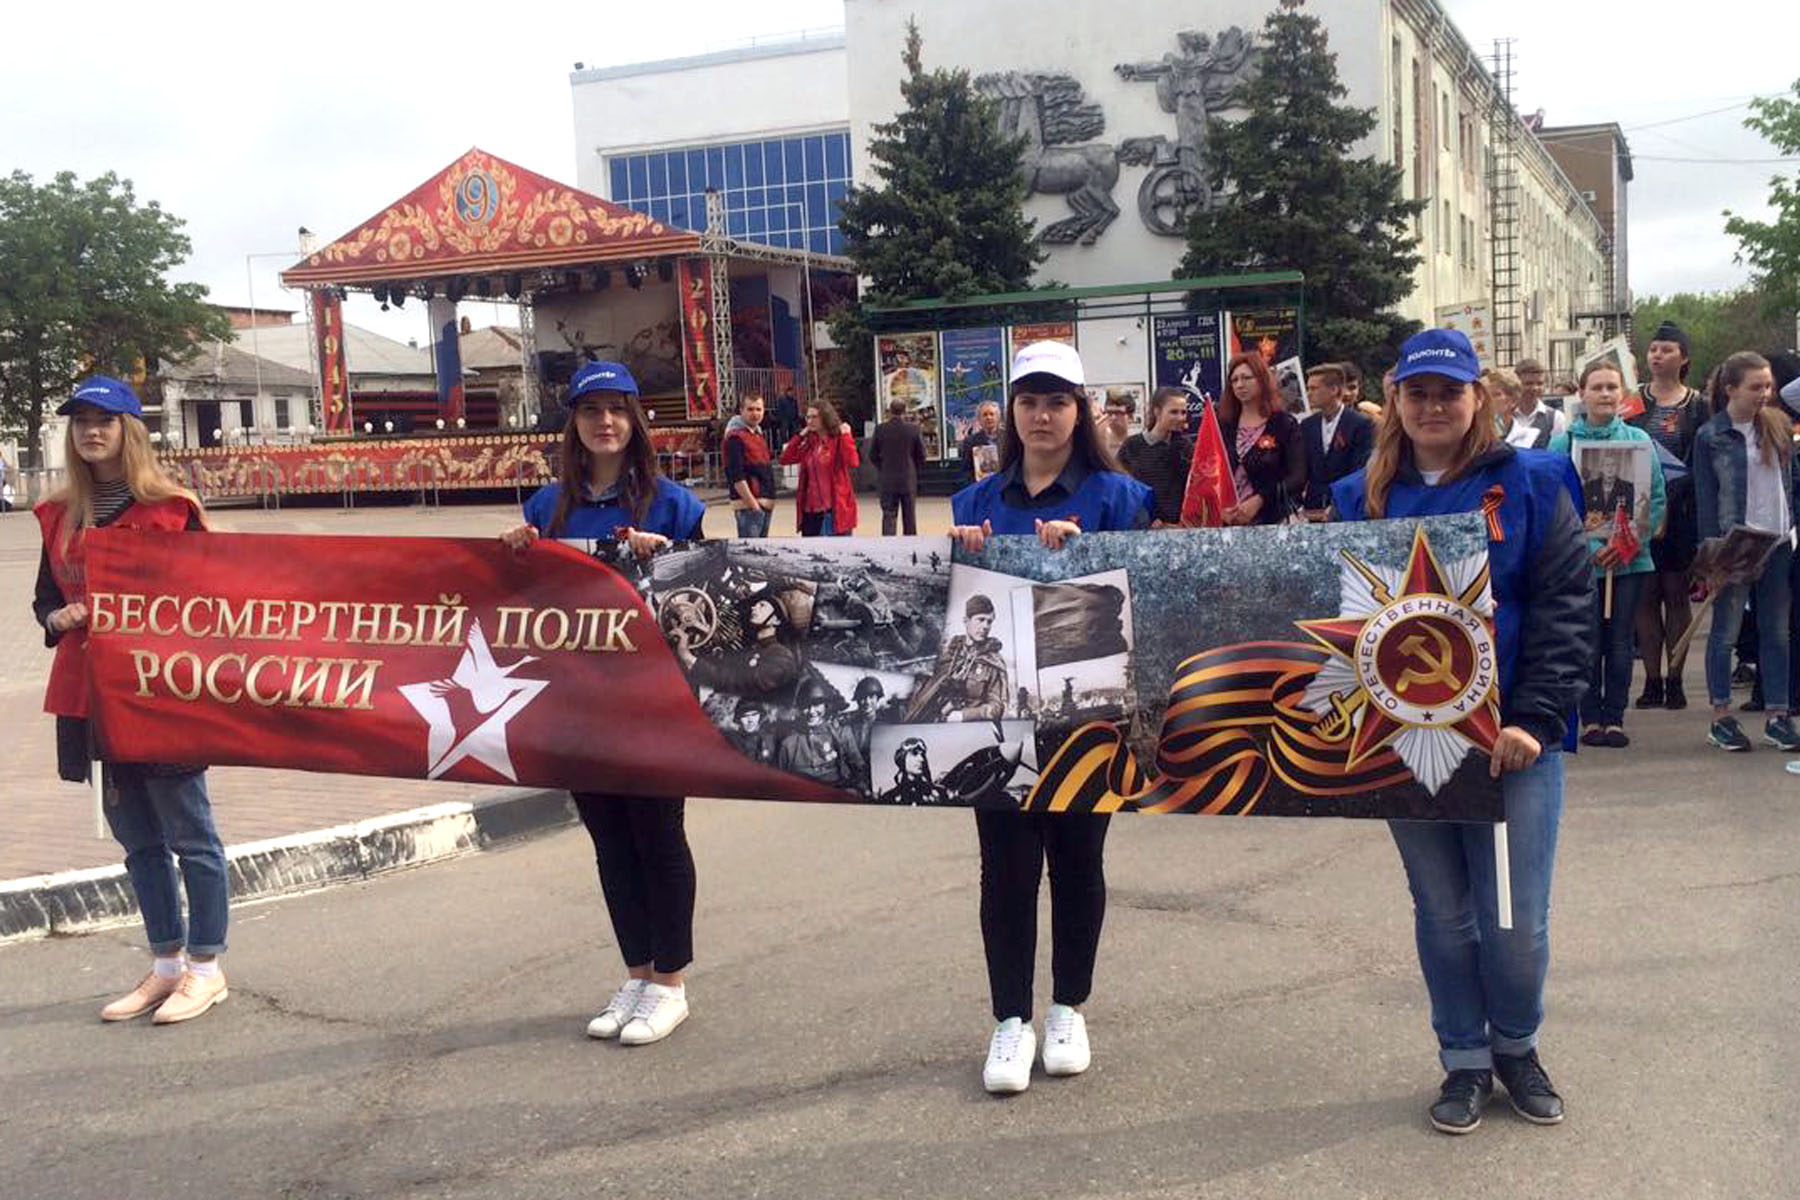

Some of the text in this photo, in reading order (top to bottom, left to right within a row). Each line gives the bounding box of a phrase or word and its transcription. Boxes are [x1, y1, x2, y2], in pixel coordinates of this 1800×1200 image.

[464, 171, 489, 224] 9
[324, 306, 343, 414] 1945
[690, 278, 708, 398] 2017
[91, 592, 639, 652] БЕССМЕРТНЫЙ ПОЛК
[1361, 600, 1481, 711] ОТЕЧЕСТВЕННАЯ
[129, 648, 385, 710] РОССИИ
